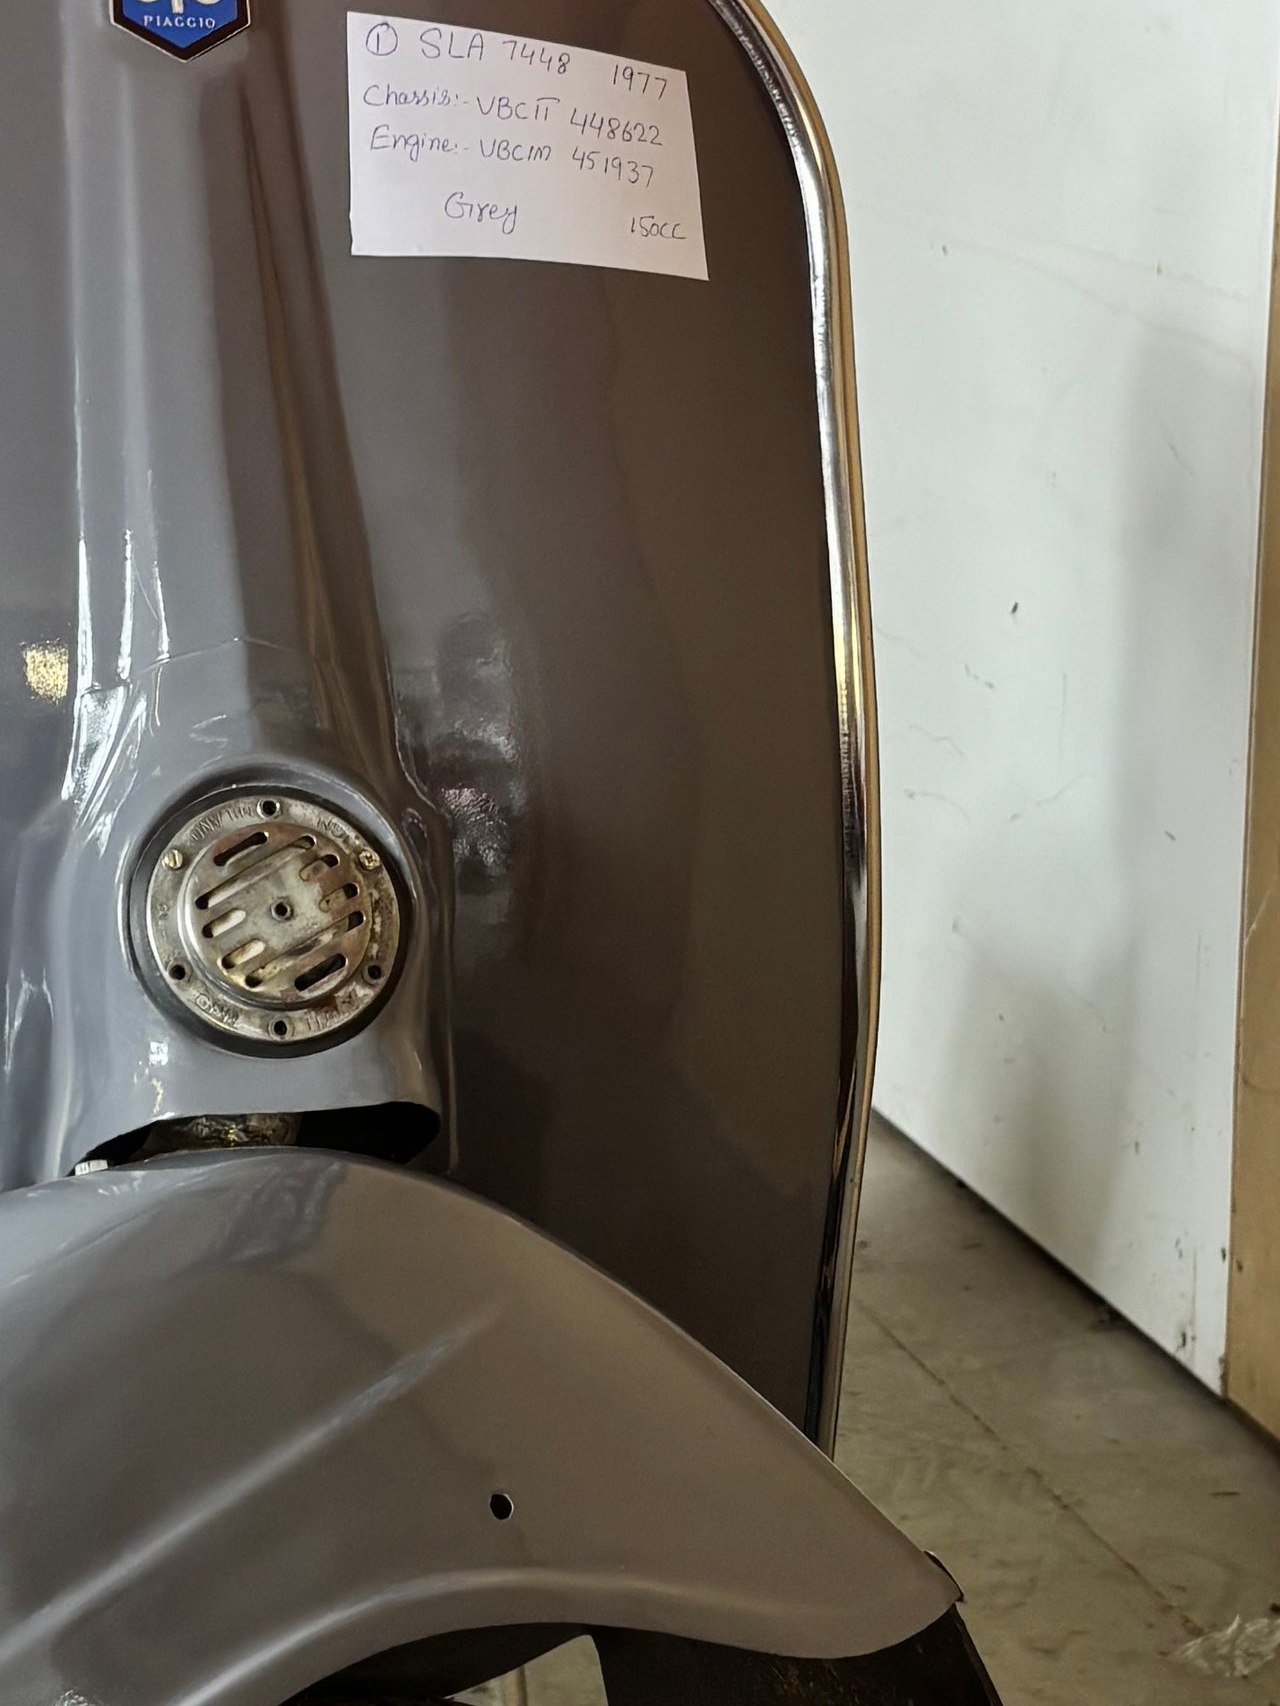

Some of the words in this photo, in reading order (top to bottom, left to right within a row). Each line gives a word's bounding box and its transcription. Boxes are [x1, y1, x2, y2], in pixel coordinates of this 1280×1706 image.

[143, 14, 216, 29] PIAGGIO
[420, 27, 484, 61] SLA
[502, 39, 571, 74] 7448
[612, 63, 668, 101] 1977
[569, 108, 663, 147] 448622
[571, 145, 655, 188] 451937
[444, 191, 518, 235] Grey
